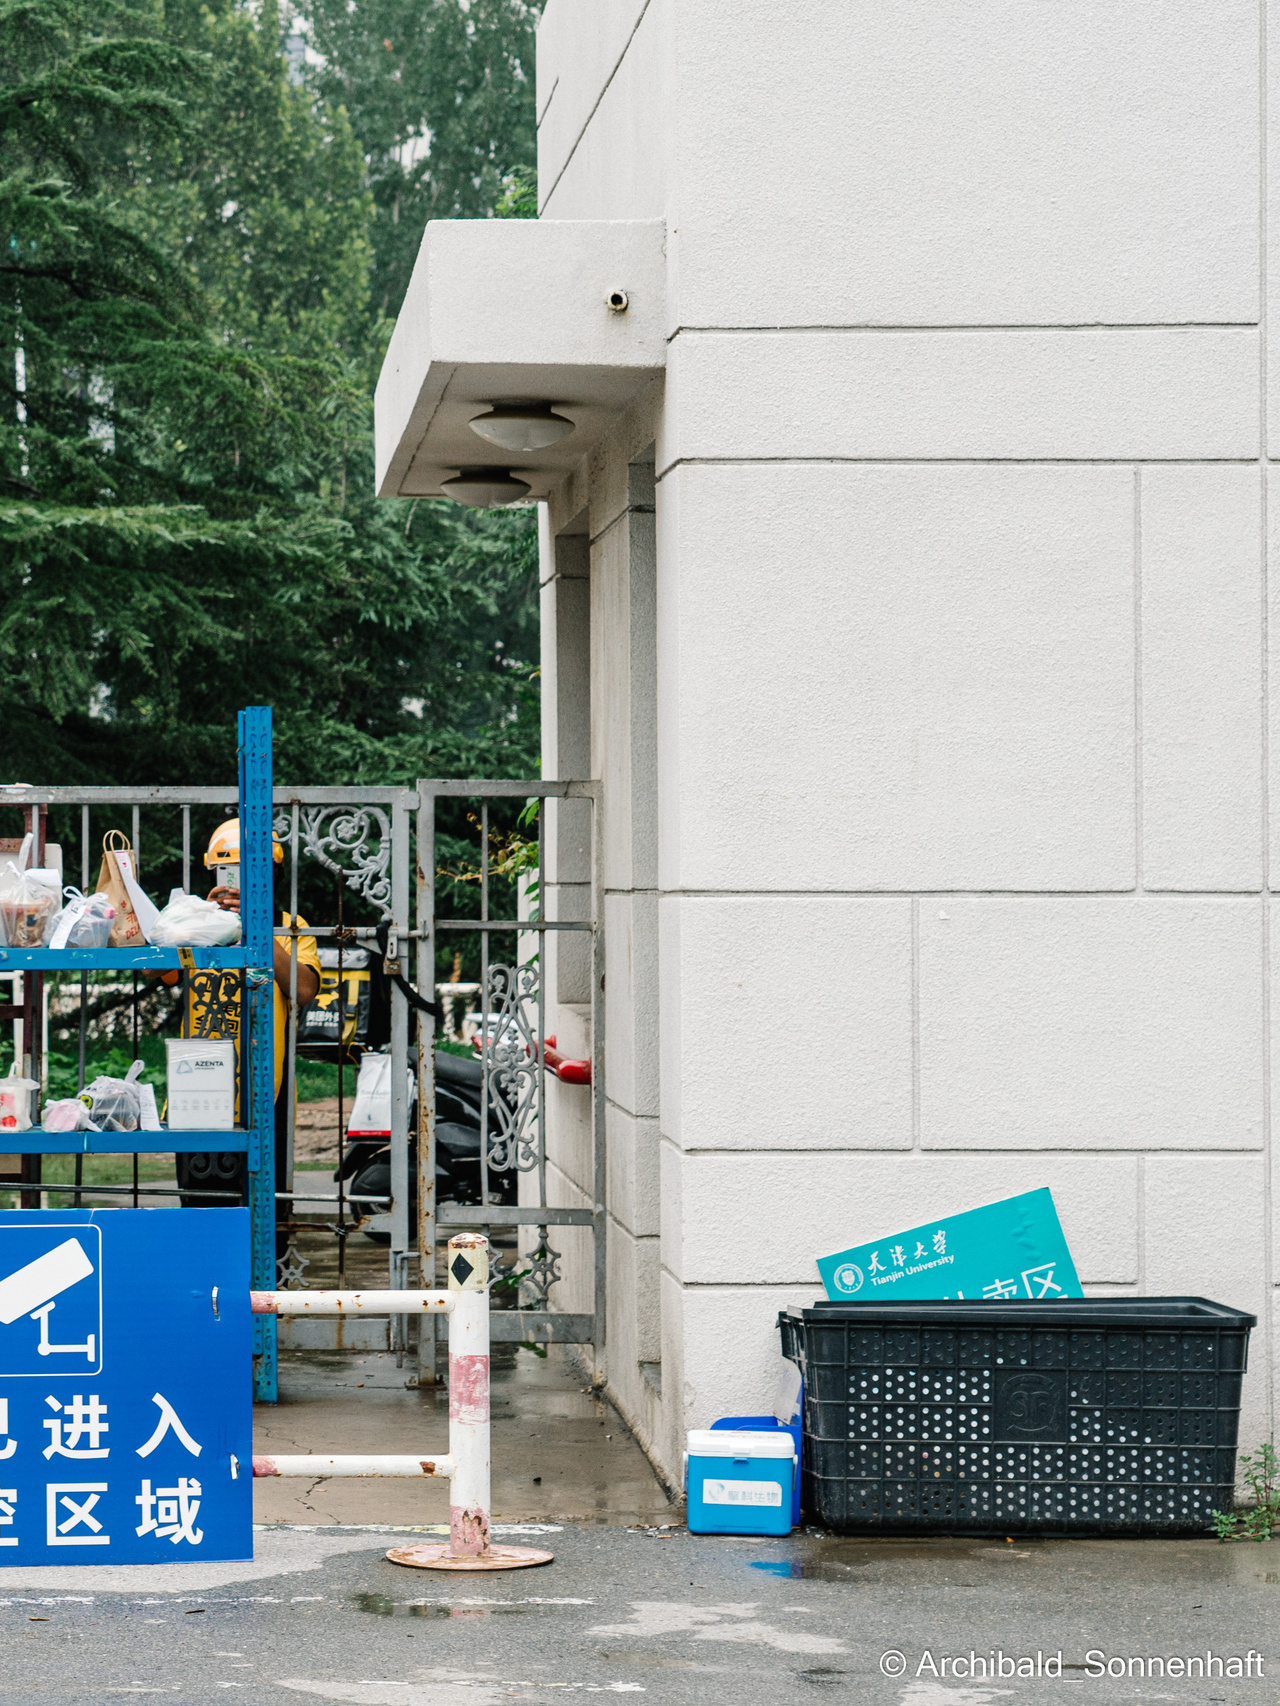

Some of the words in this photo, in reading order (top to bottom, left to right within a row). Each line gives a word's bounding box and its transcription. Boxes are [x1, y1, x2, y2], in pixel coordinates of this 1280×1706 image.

[868, 1230, 947, 1276] 天津大学
[870, 1270, 905, 1287] Tianjin
[906, 1254, 955, 1276] University
